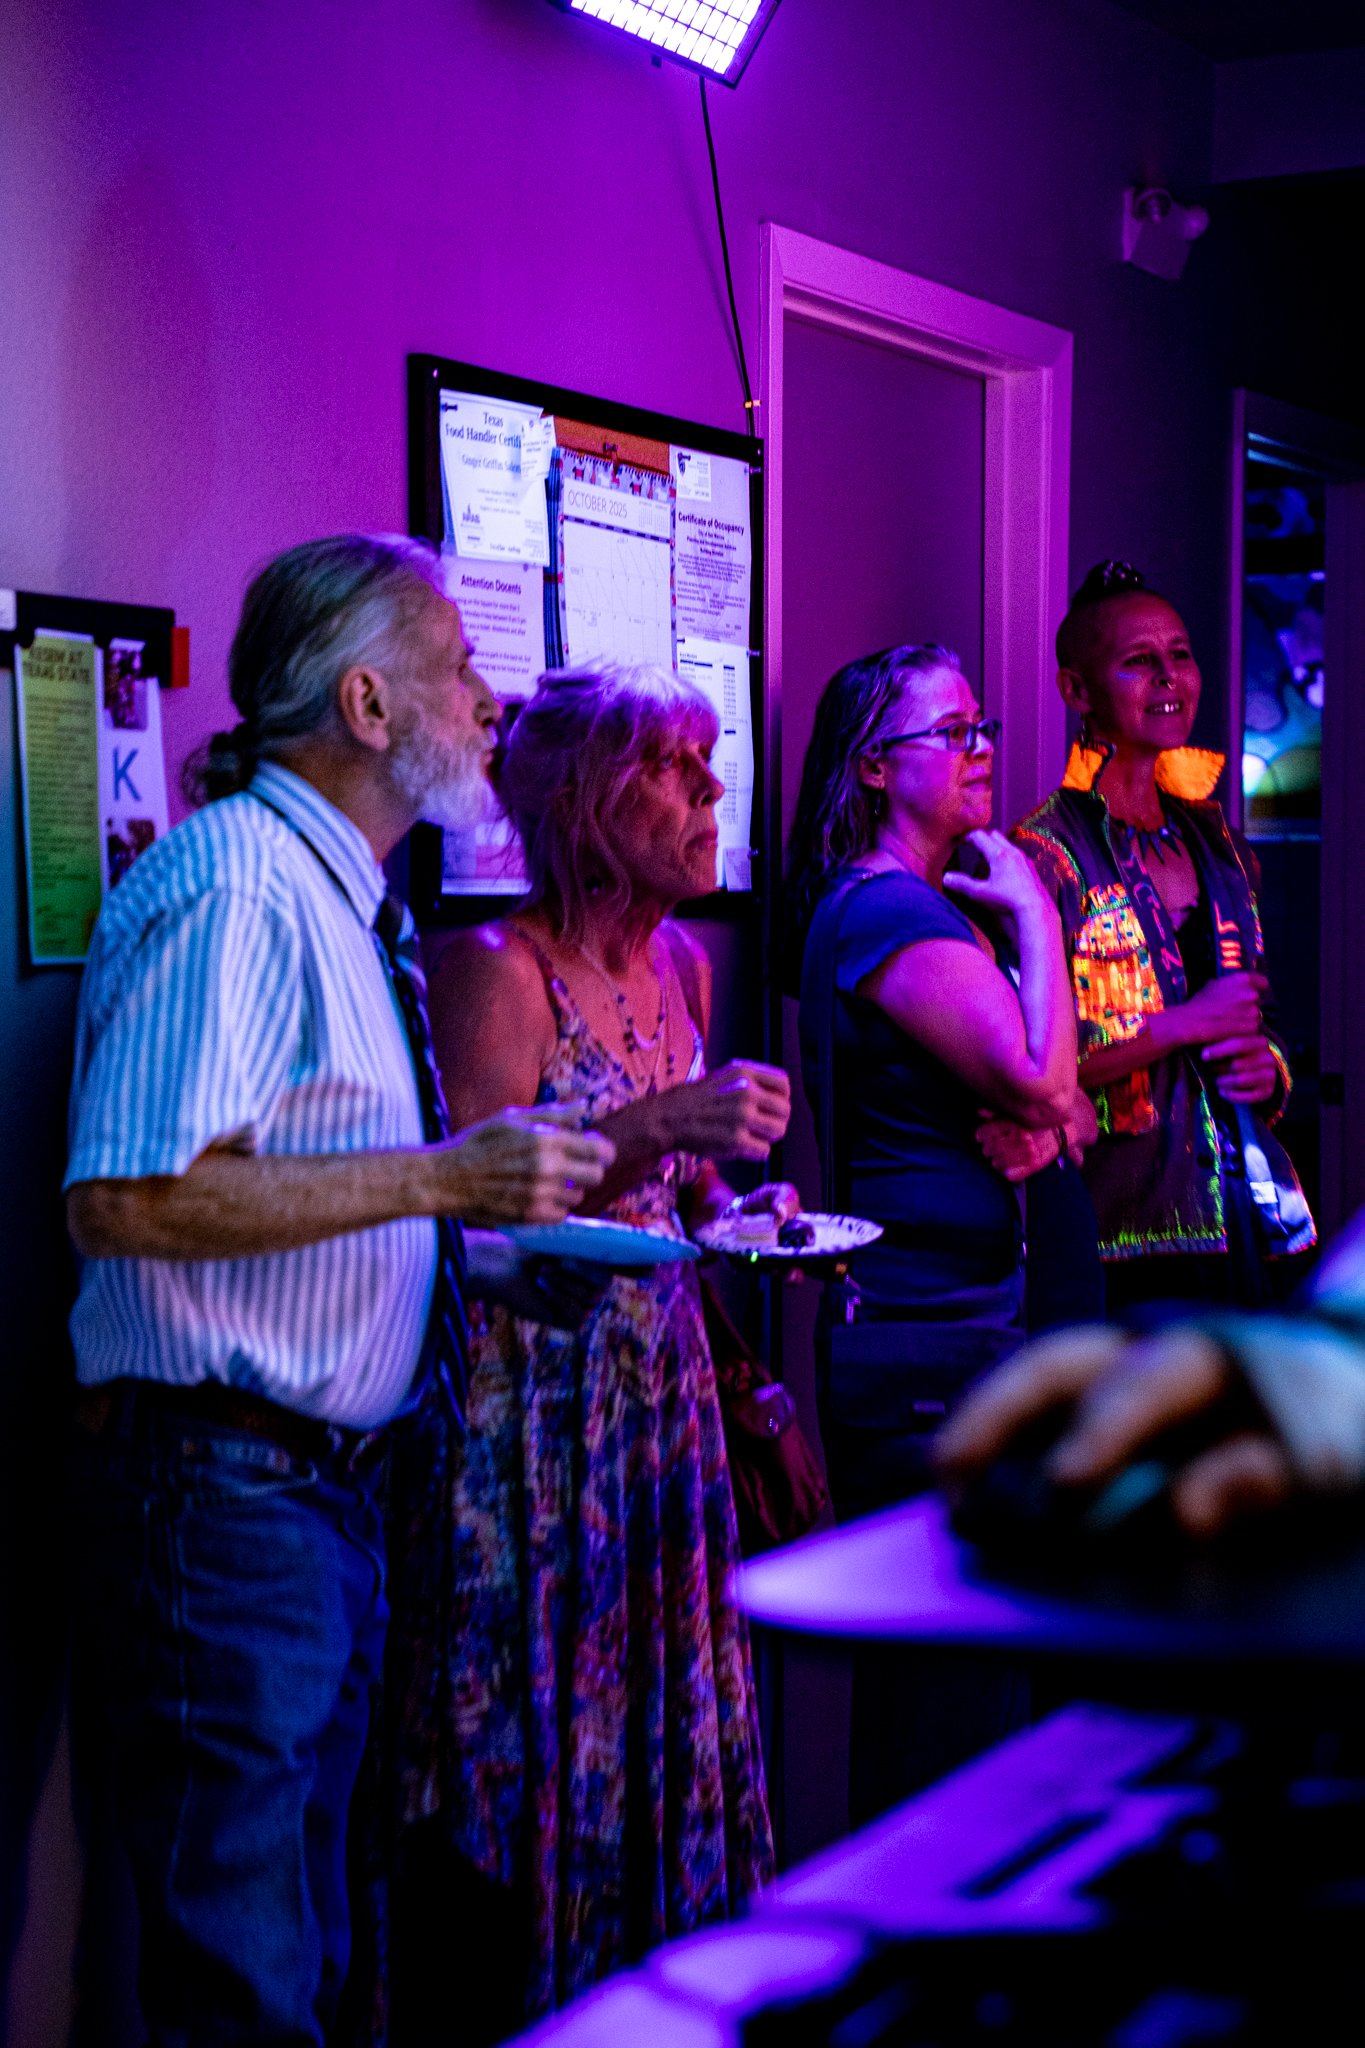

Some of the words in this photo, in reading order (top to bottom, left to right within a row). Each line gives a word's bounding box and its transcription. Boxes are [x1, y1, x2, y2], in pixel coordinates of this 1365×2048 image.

[483, 412, 503, 428] Texas
[445, 423, 464, 439] Food
[466, 427, 497, 445] Handler
[499, 433, 522, 449] Certifi
[568, 489, 607, 513] OCTOBER
[608, 500, 628, 519] 2025
[678, 512, 706, 527] Certificate
[707, 517, 713, 528] of
[714, 519, 744, 536] Occupancy
[461, 574, 494, 591] Attention
[495, 579, 522, 595] Docents
[113, 748, 142, 801] K
